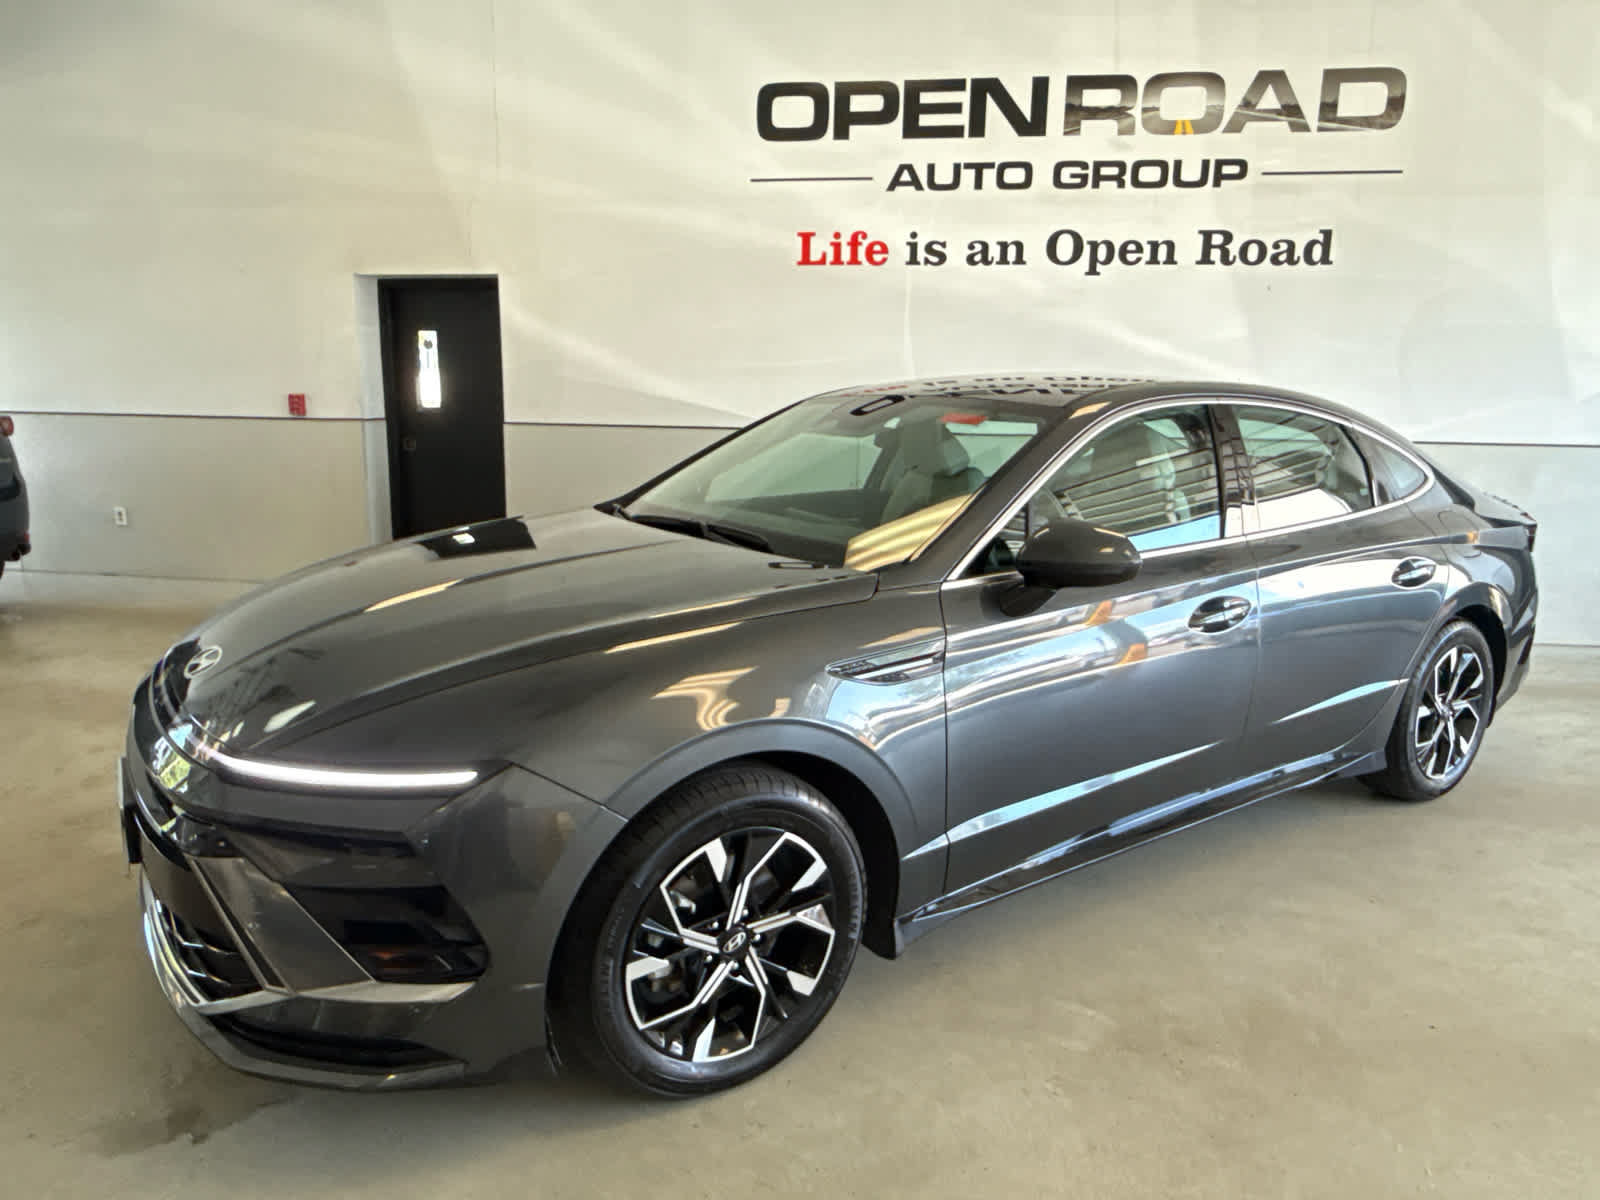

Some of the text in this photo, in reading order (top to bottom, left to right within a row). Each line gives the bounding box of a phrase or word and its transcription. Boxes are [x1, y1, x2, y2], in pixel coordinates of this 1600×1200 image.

[756, 66, 1408, 143] OPEN ROAD
[886, 158, 1249, 193] AUTO GROUP
[796, 228, 1334, 276] Life is an Open Road
